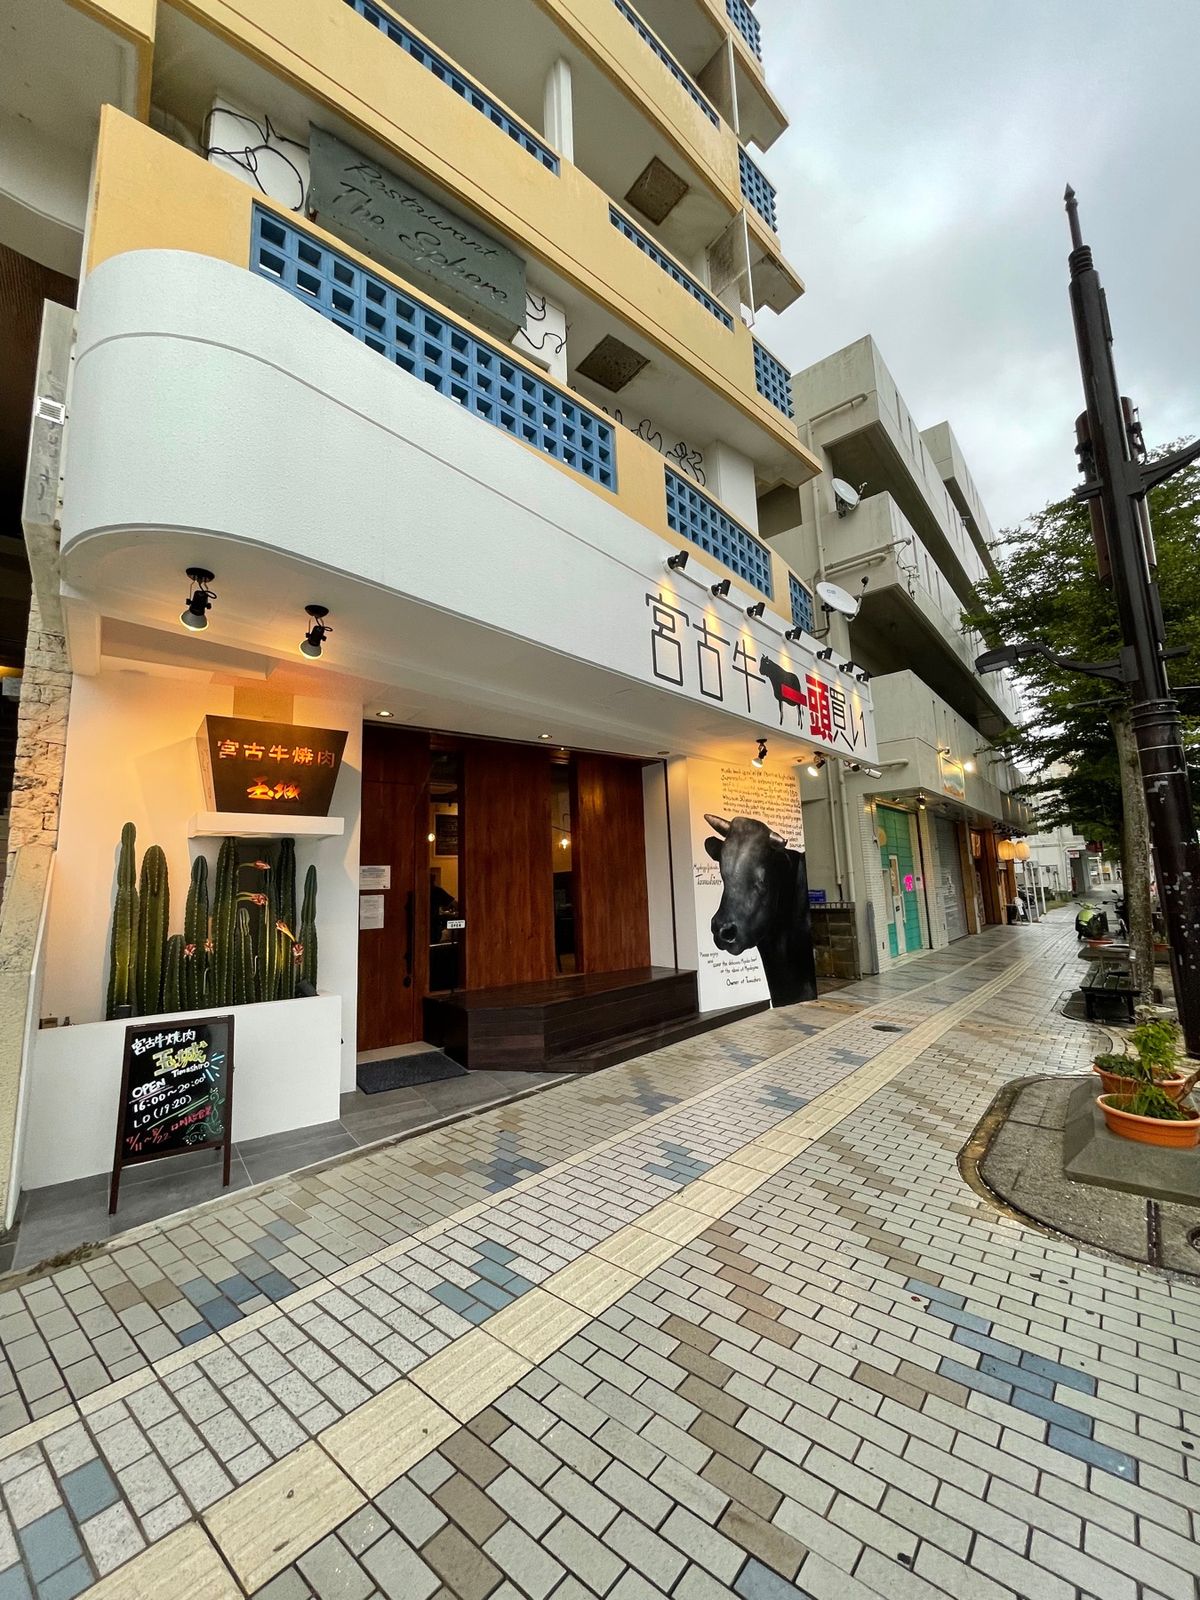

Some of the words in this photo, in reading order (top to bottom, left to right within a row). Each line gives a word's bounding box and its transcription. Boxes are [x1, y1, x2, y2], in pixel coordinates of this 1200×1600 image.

[332, 181, 386, 231] The
[344, 161, 499, 257] Restaurant
[645, 592, 868, 752] 宮古牛一頭買い
[217, 739, 336, 769] 宮古牛焼肉
[131, 1028, 197, 1056] 宮古牛焼肉
[131, 1077, 166, 1099] OPEN
